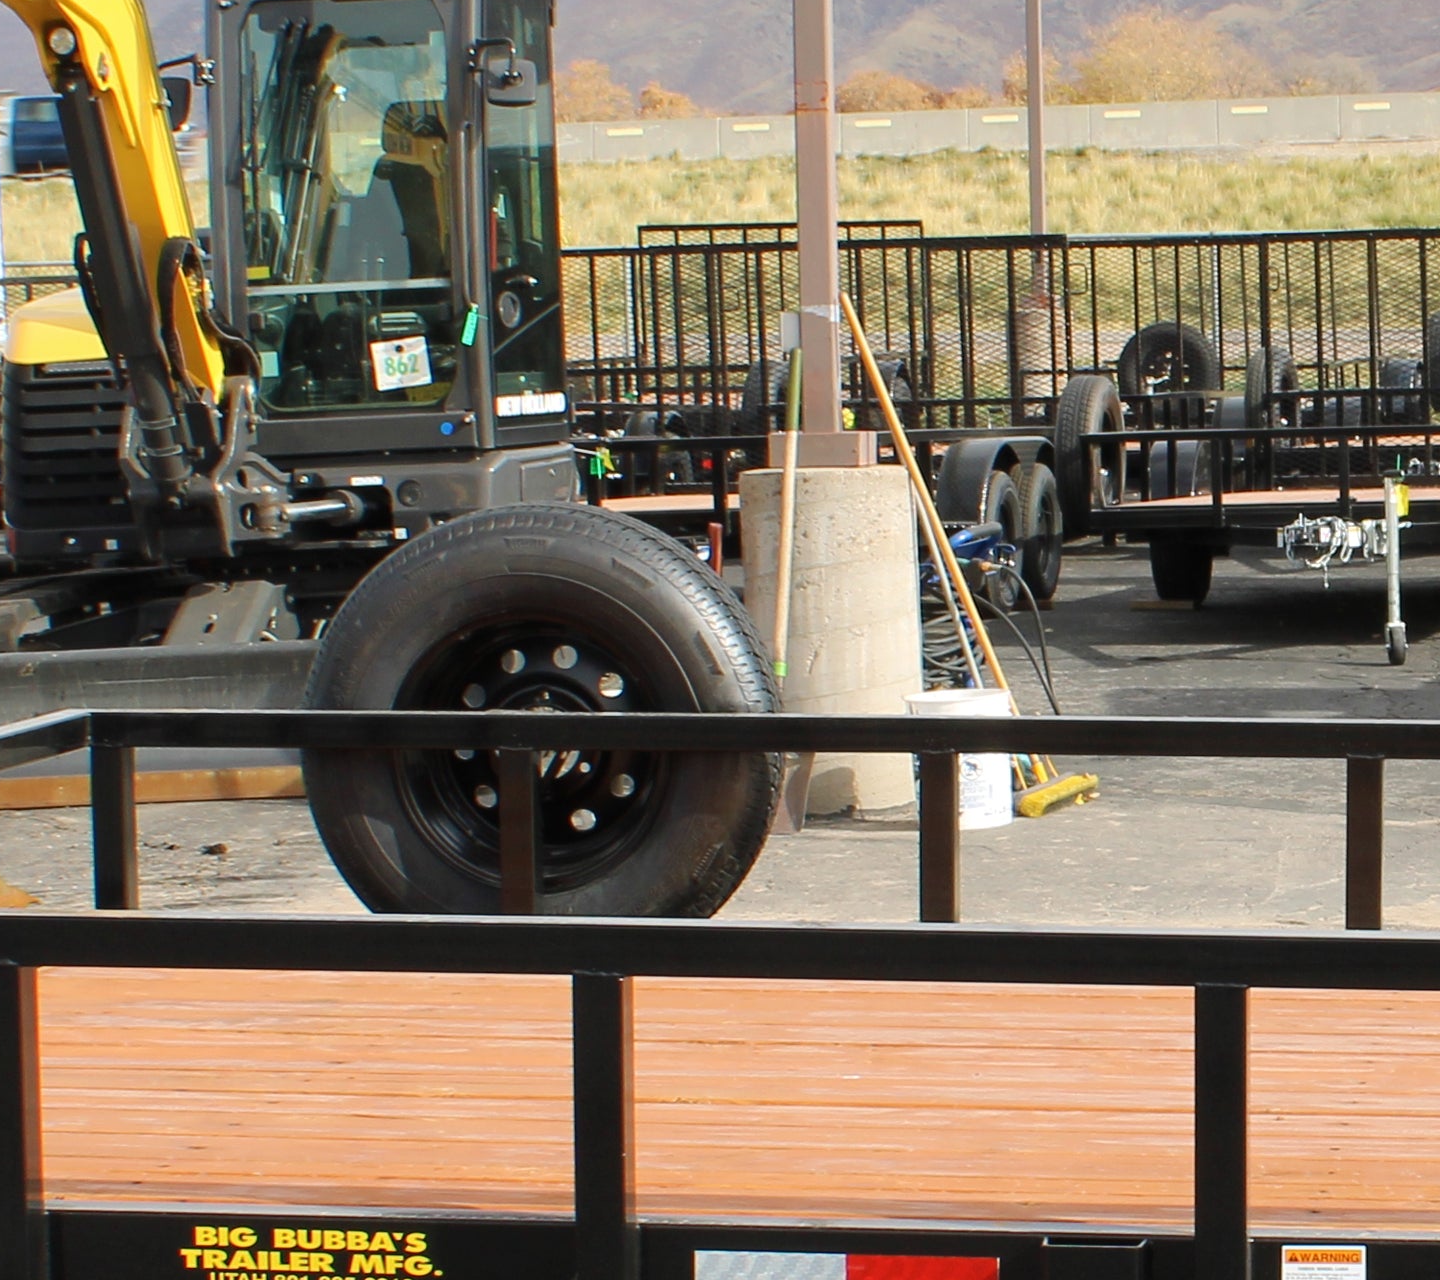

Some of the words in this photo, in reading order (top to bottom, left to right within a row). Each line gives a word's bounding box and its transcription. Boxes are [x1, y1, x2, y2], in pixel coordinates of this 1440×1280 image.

[383, 352, 421, 378] 862
[194, 1225, 258, 1248] BIG
[273, 1228, 427, 1253] BUBBA'S
[180, 1249, 335, 1272] TRAILER
[349, 1253, 443, 1277] MFG.
[1300, 1252, 1360, 1263] WARNING
